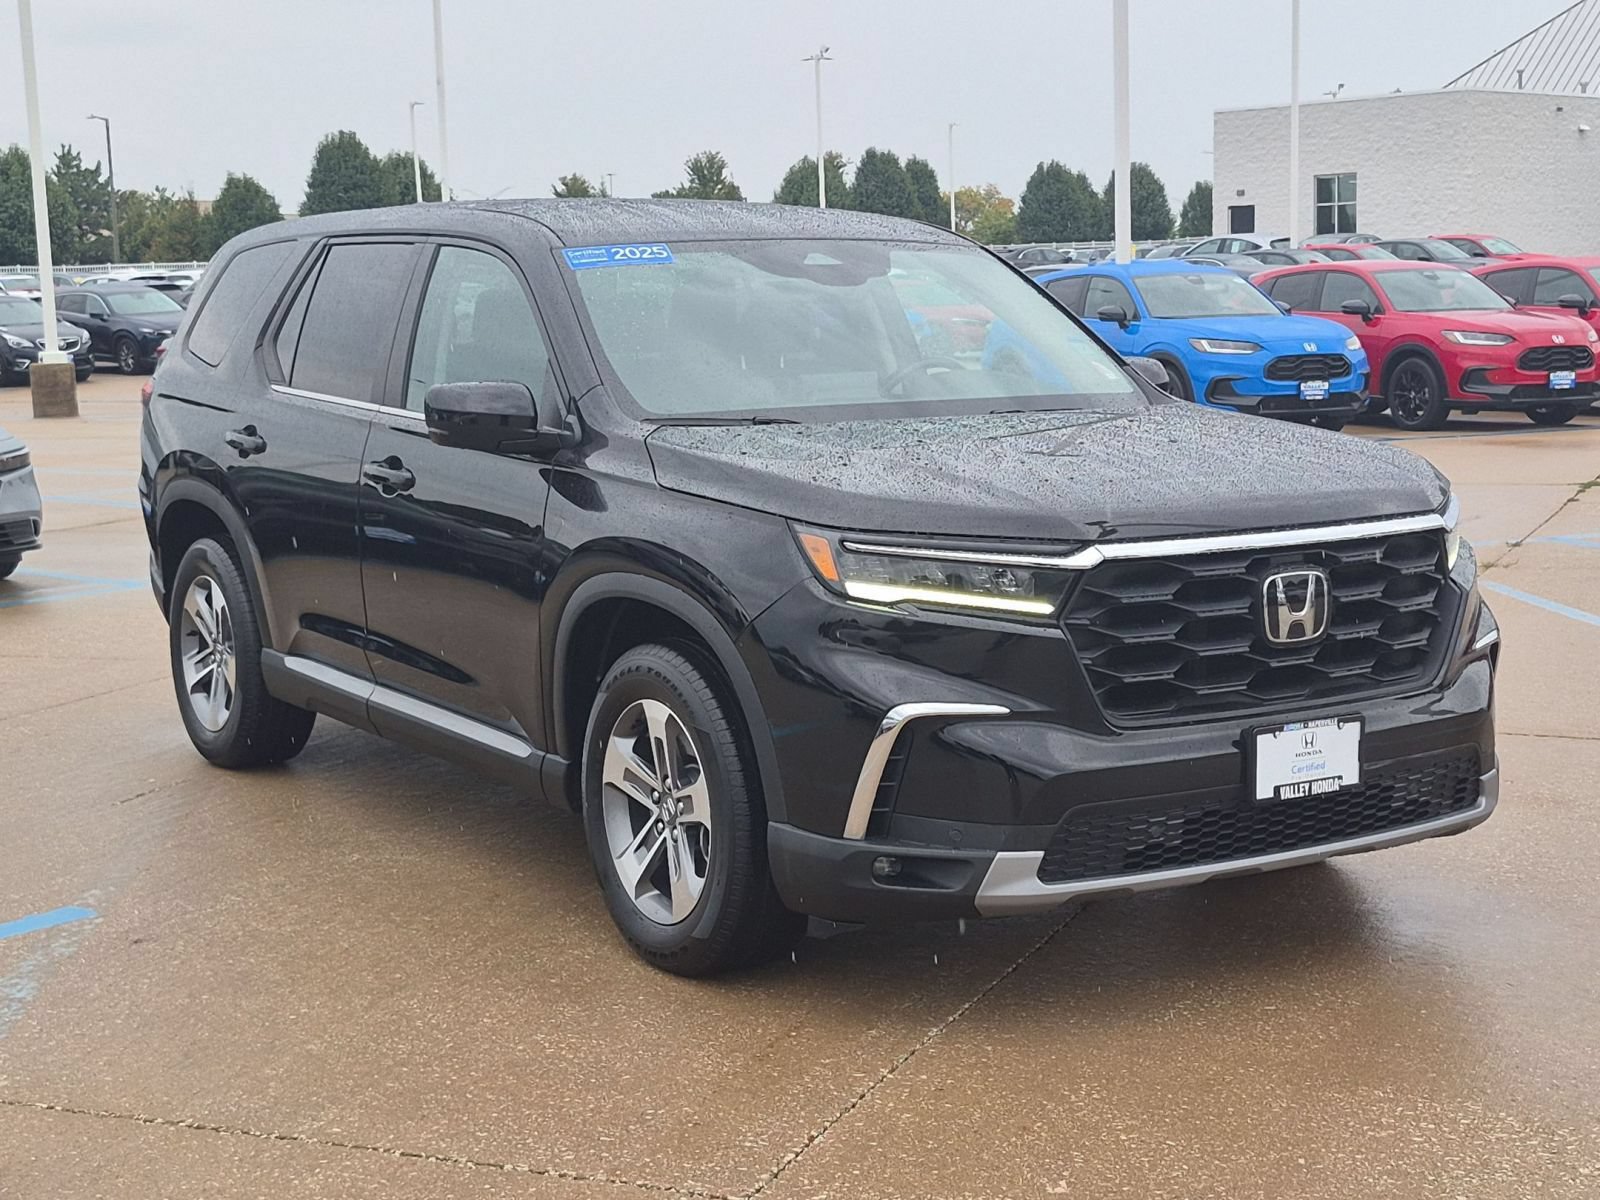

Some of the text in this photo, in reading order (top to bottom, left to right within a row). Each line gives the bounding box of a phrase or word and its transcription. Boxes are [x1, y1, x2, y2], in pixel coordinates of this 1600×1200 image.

[610, 246, 669, 260] 2025
[1295, 749, 1323, 758] HONDA
[1291, 760, 1326, 775] Certified
[1280, 777, 1340, 800] VALLEY HONDA
